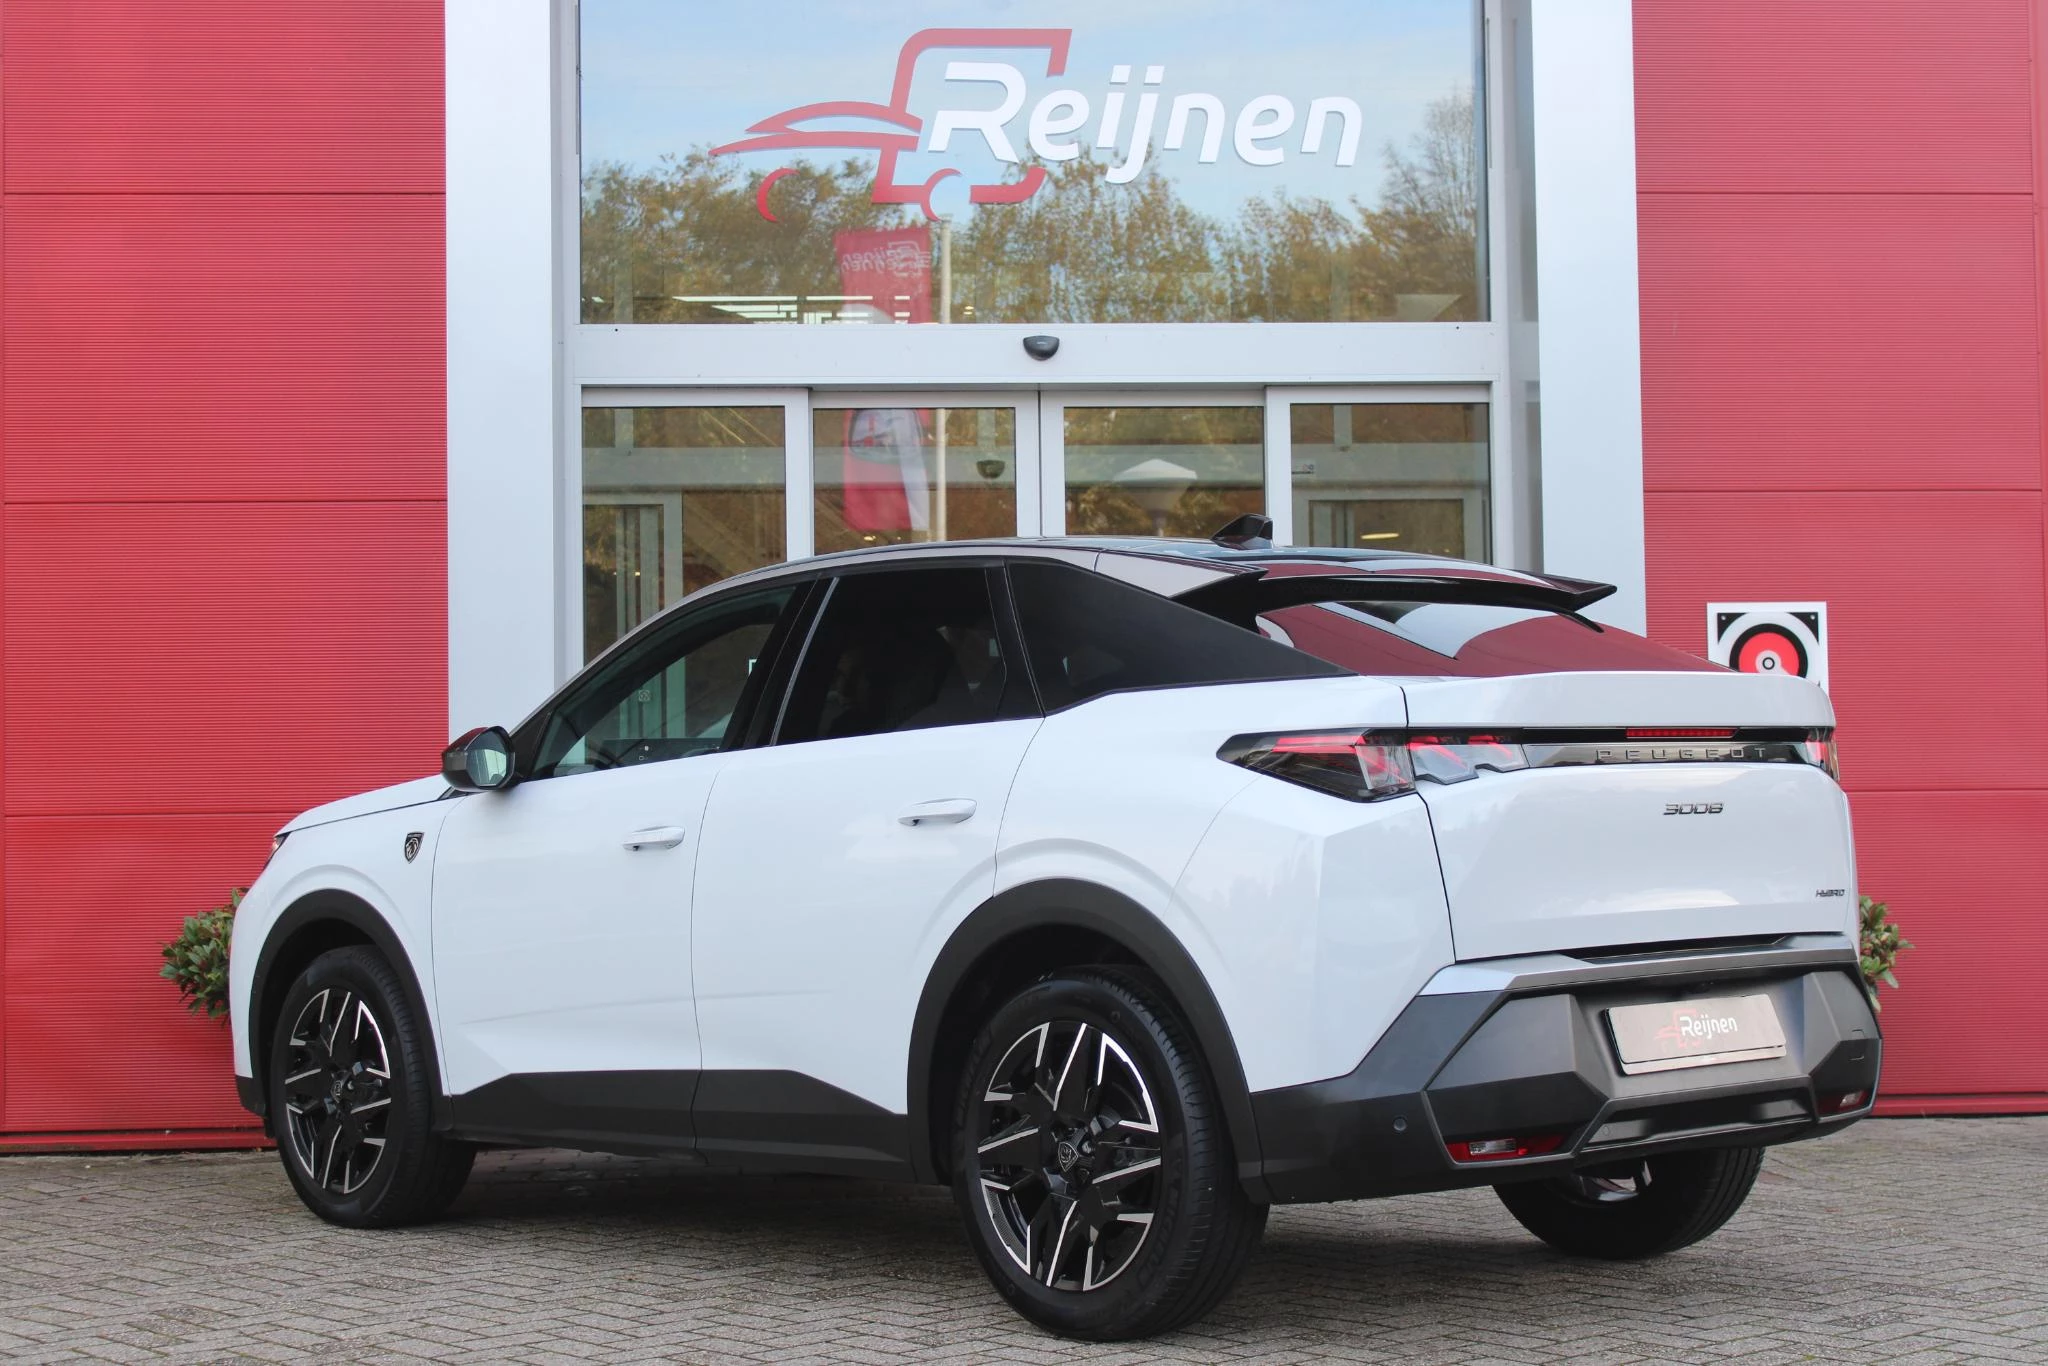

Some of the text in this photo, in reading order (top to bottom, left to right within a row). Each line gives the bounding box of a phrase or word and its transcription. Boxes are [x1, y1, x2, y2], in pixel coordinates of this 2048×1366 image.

[928, 62, 1362, 184] Reijnen
[1596, 747, 1766, 761] PEUGEOT
[1680, 1014, 1738, 1039] Reijnen
